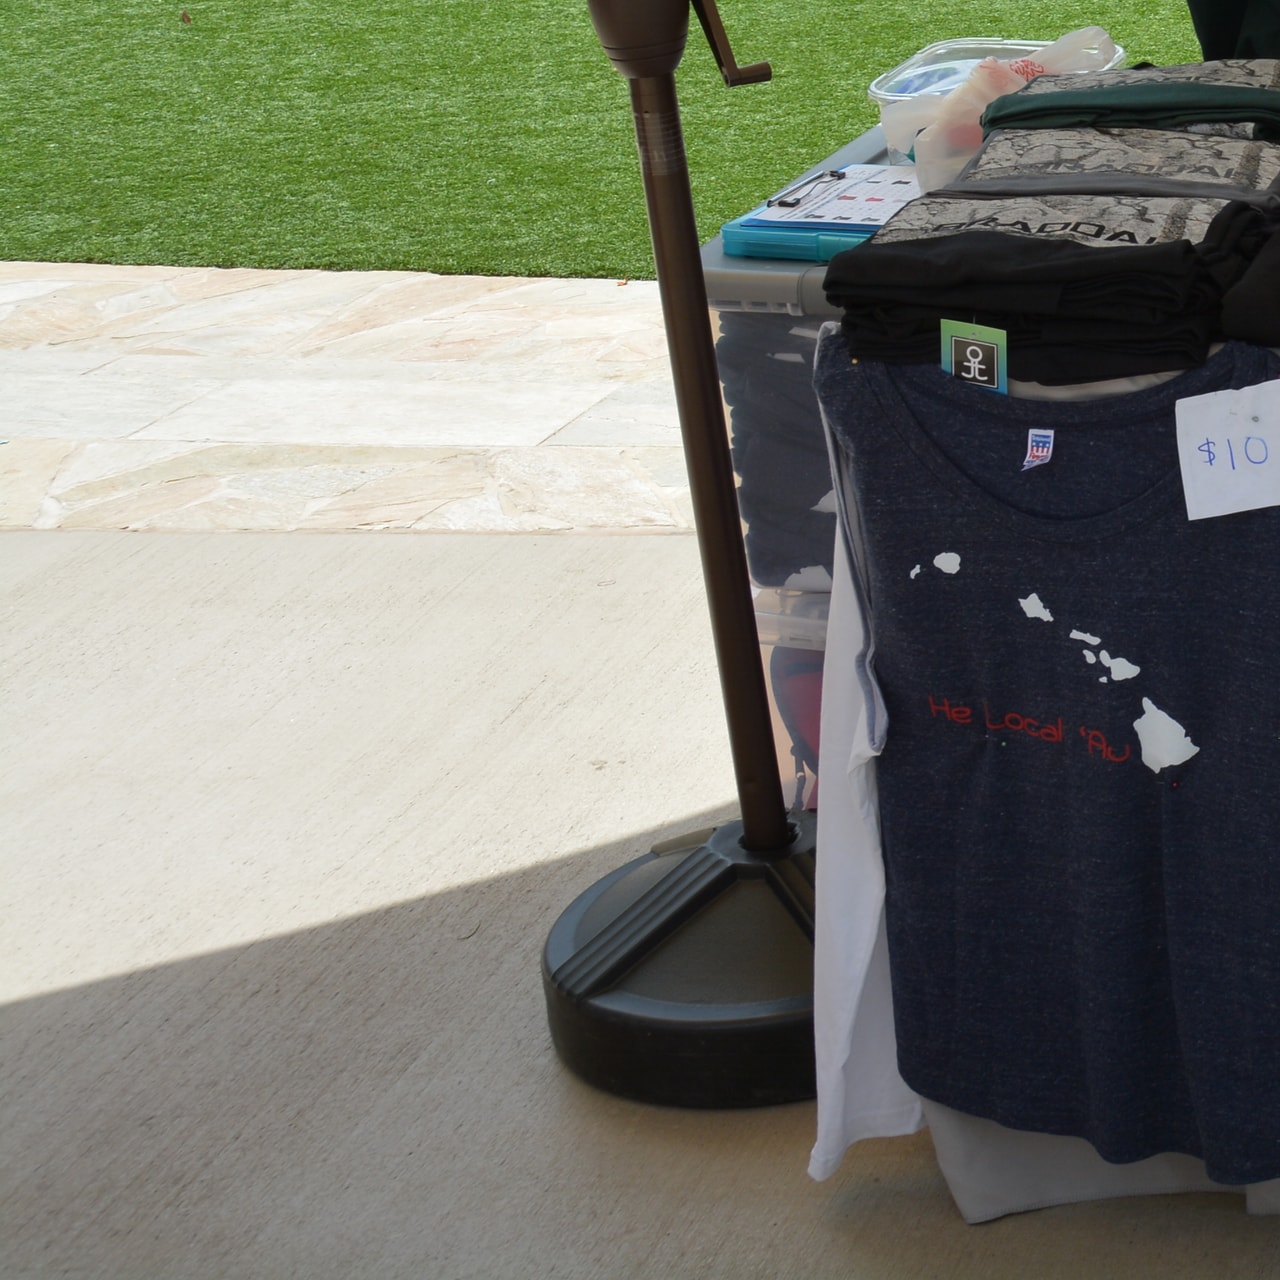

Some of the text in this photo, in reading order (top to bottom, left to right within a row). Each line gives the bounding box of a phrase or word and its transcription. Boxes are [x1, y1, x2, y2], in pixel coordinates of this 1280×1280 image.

[1197, 436, 1269, 471] $10
[928, 694, 973, 724] He
[983, 697, 1064, 742] Local
